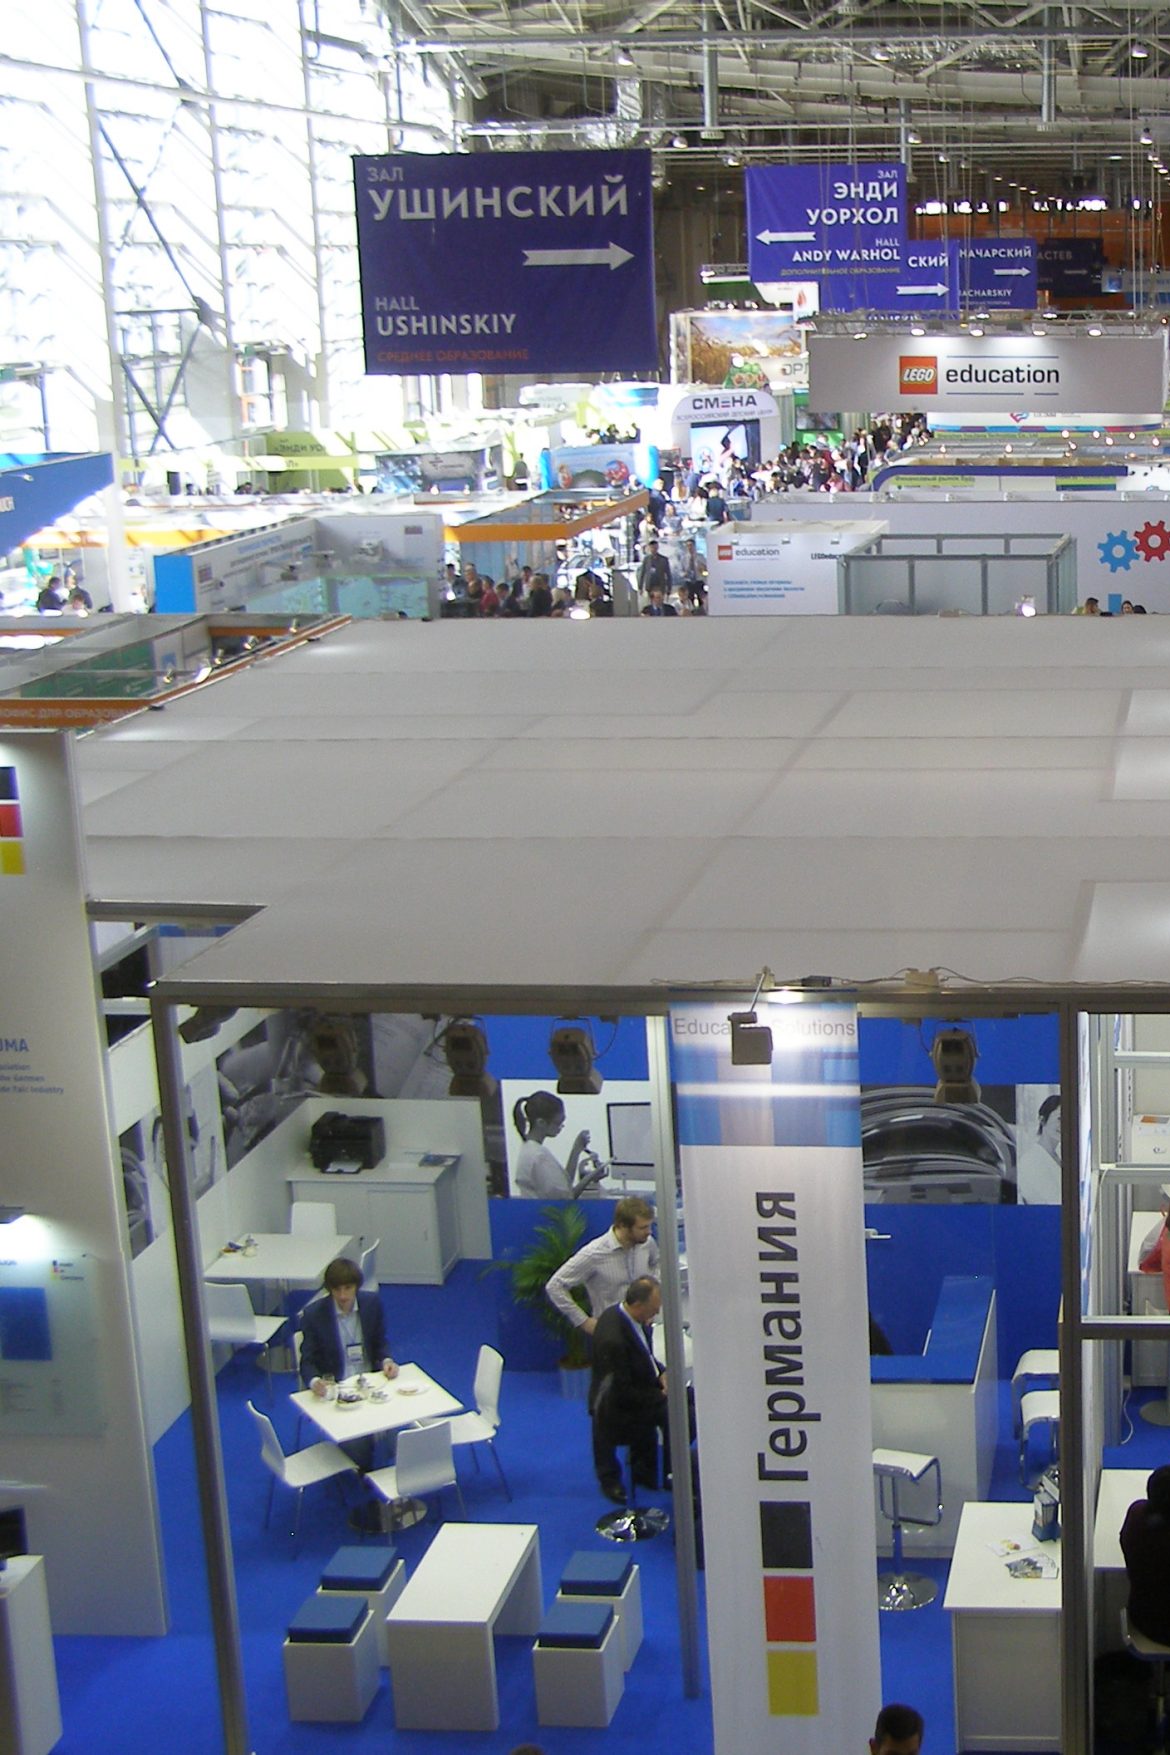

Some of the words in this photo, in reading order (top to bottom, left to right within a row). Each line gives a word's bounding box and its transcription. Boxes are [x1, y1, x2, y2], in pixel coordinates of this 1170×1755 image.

[367, 167, 403, 182] ЗАЛ
[877, 170, 898, 179] ЗАЛ
[368, 174, 628, 221] УШИНСКИЙ
[833, 182, 898, 201] ЭНДИ
[806, 207, 898, 225] УОРХОЛ
[875, 238, 900, 247] HALL
[792, 250, 832, 262] ANDY
[836, 248, 900, 261] WARHOL
[376, 297, 420, 311] HALL
[376, 314, 517, 337] USHINSKIY
[436, 349, 529, 361] ОБРАЗОВАНИЕ
[903, 367, 935, 383] LEGO
[946, 364, 1060, 383] education
[736, 547, 780, 556] education
[755, 1192, 821, 1481] Германия
